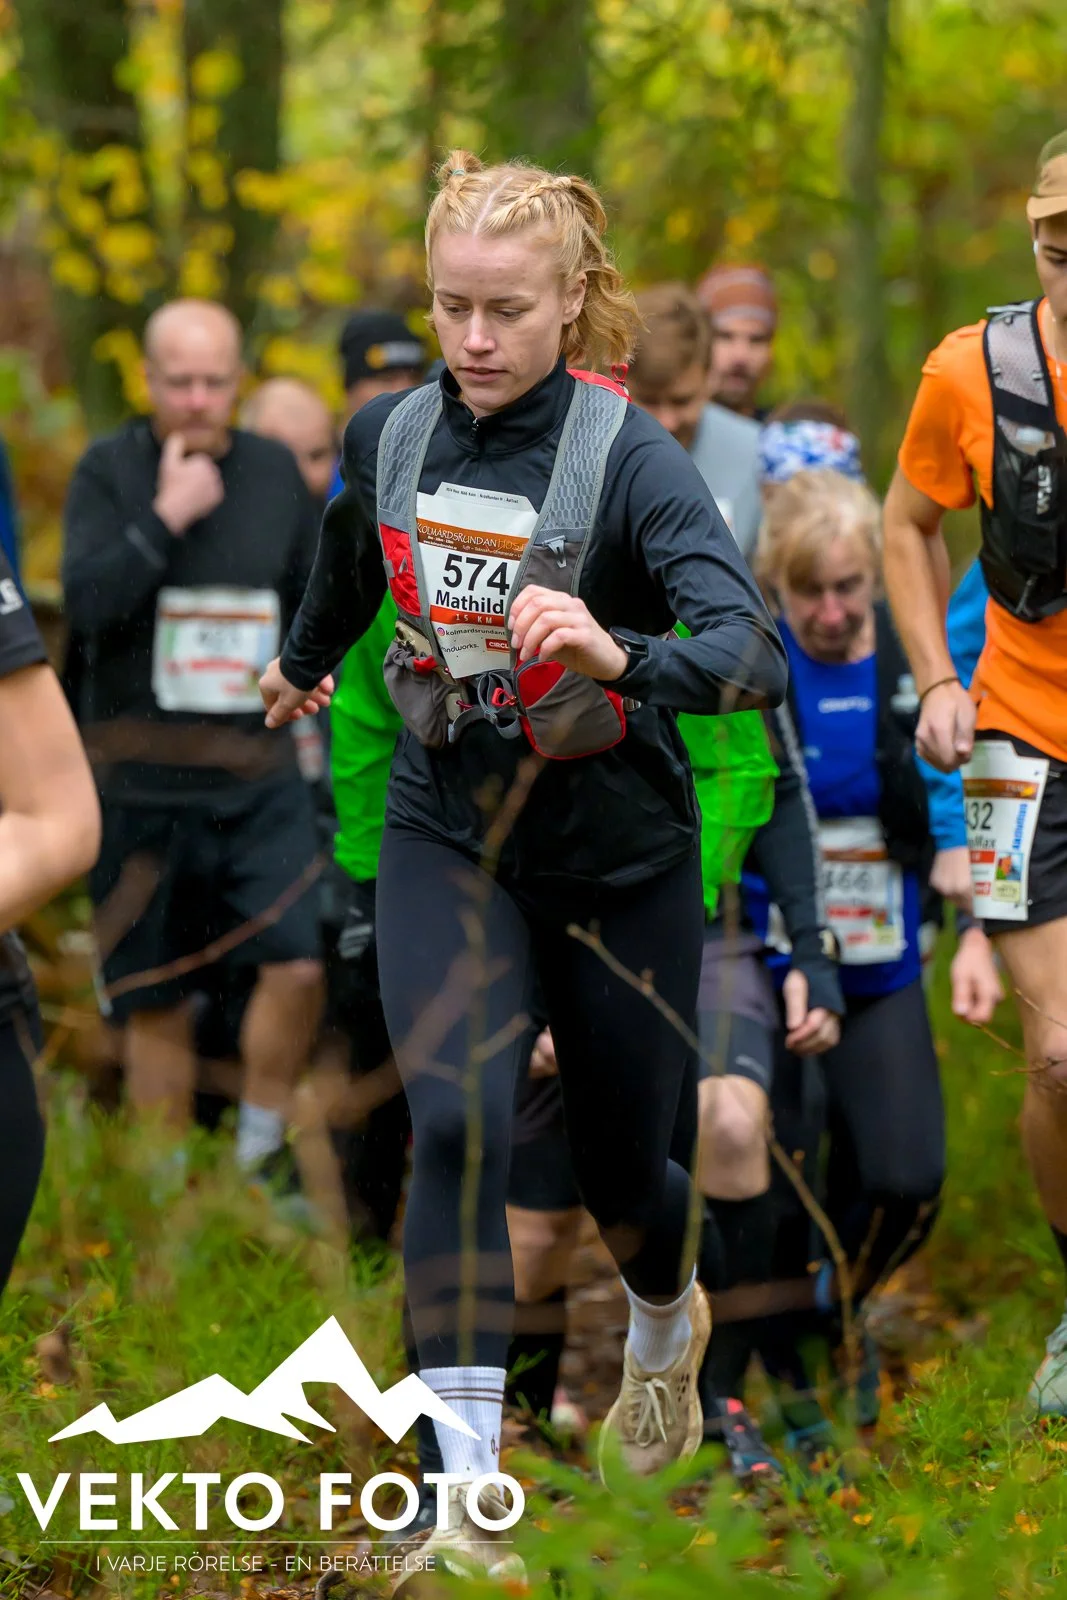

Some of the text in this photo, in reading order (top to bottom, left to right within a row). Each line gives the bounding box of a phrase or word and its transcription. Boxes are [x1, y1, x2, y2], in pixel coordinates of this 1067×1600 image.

[443, 553, 510, 596] 574
[435, 589, 504, 615] Mathild
[455, 613, 493, 625] 15 KM
